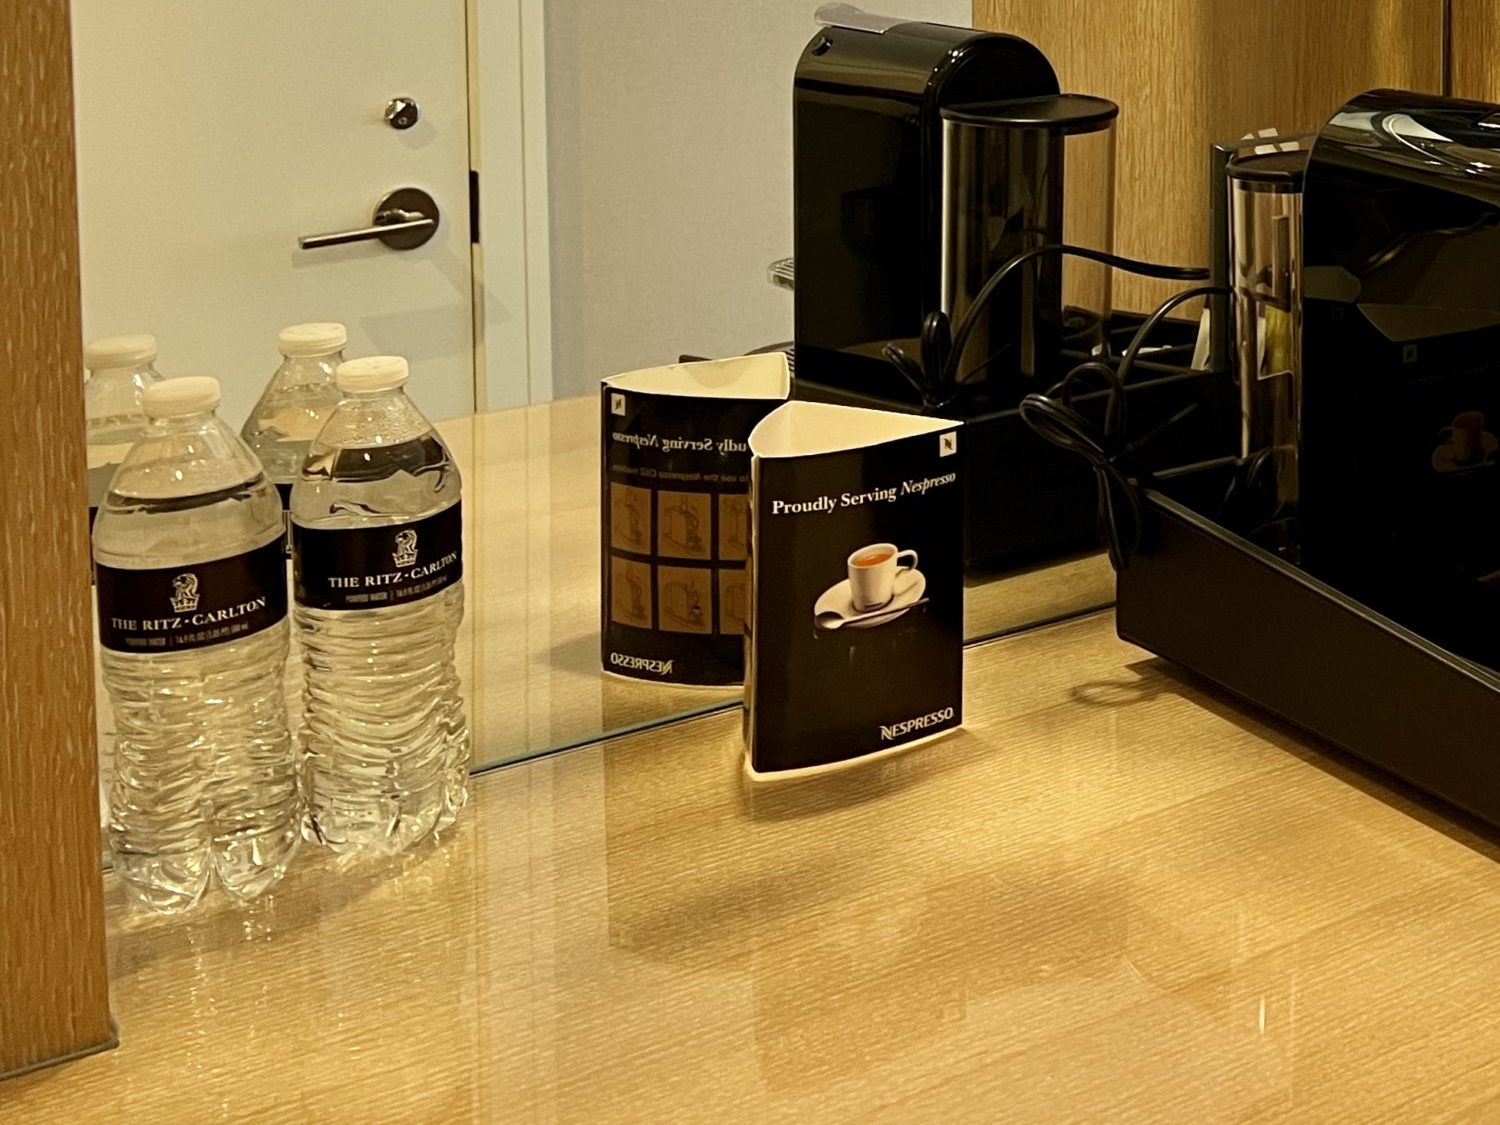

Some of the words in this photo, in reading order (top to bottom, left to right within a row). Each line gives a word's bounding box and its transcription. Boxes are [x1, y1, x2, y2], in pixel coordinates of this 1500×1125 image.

[771, 496, 837, 514] Proudly
[840, 487, 898, 507] Serving
[900, 472, 957, 496] Nespresso
[328, 576, 360, 588] THE
[111, 617, 138, 631] THE
[878, 706, 955, 741] NESPRESSO
